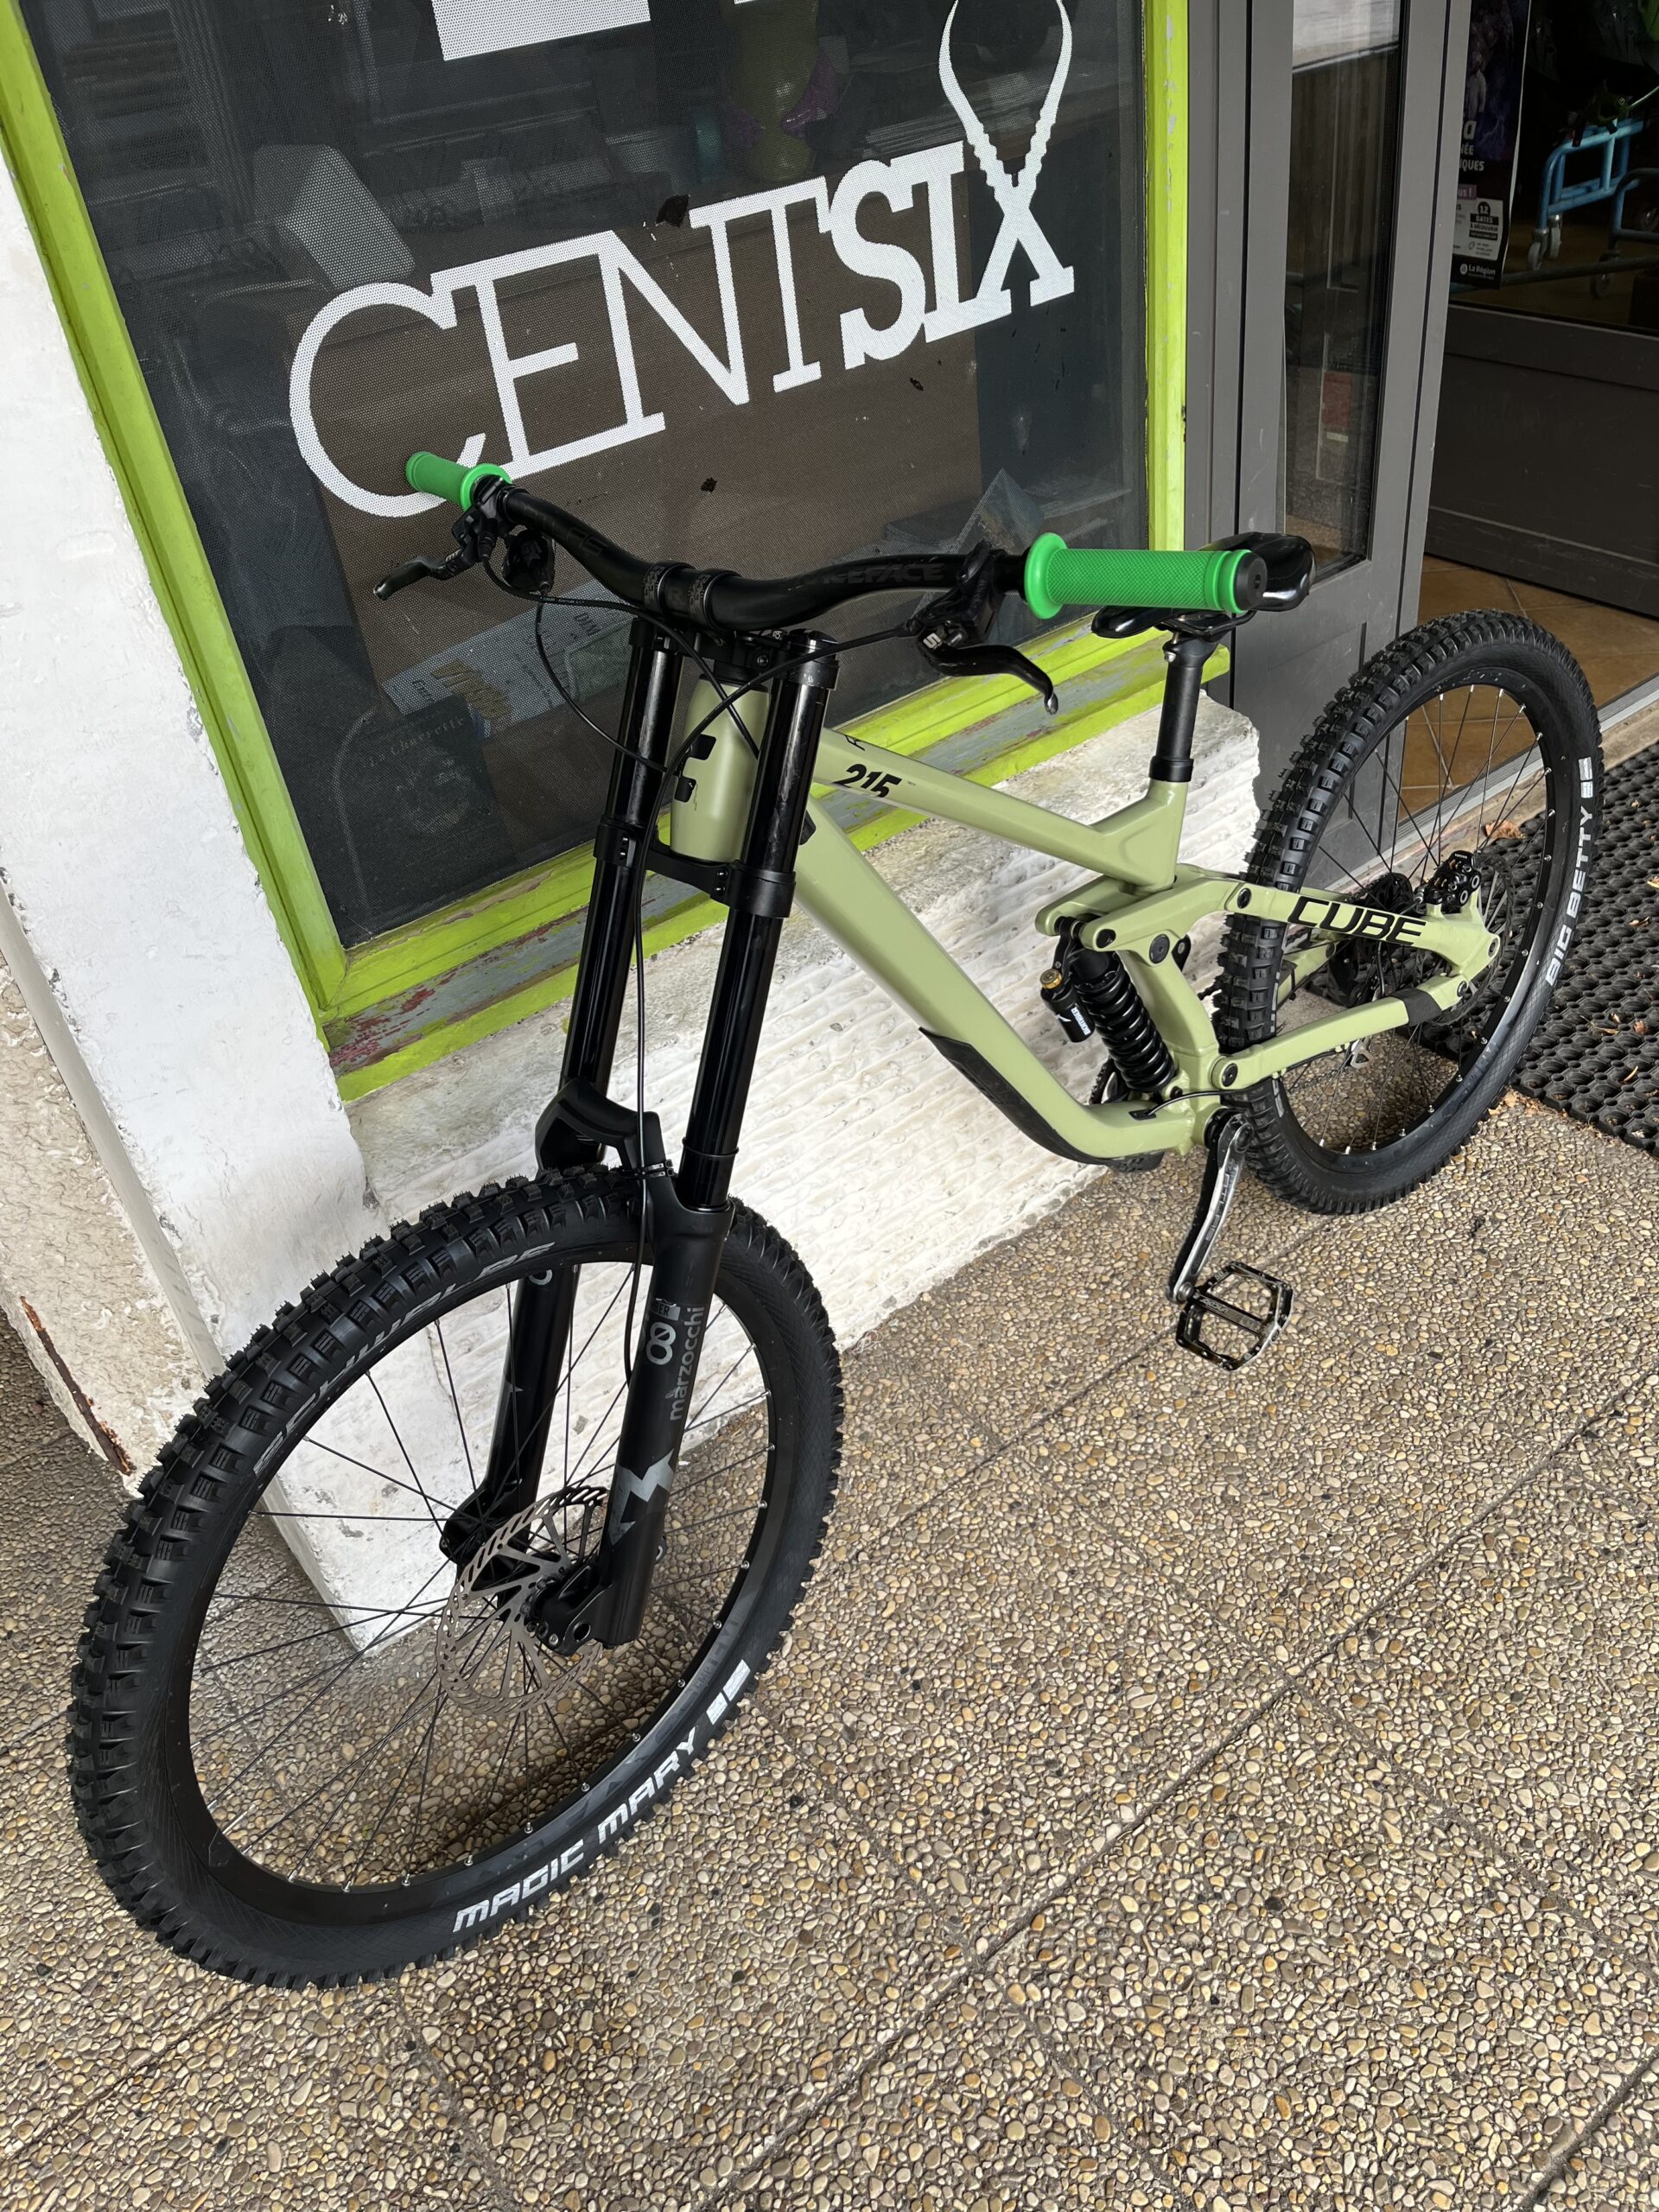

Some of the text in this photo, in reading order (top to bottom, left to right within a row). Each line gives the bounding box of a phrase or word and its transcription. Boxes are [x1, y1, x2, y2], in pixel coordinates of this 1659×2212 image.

[1476, 264, 1497, 276] Région
[832, 764, 902, 798] 215
[1287, 896, 1427, 946] CUBE
[1545, 805, 1592, 987] BIG BETTY
[670, 1306, 705, 1421] marzocchi
[452, 1726, 698, 1933] MAGIC MARY
